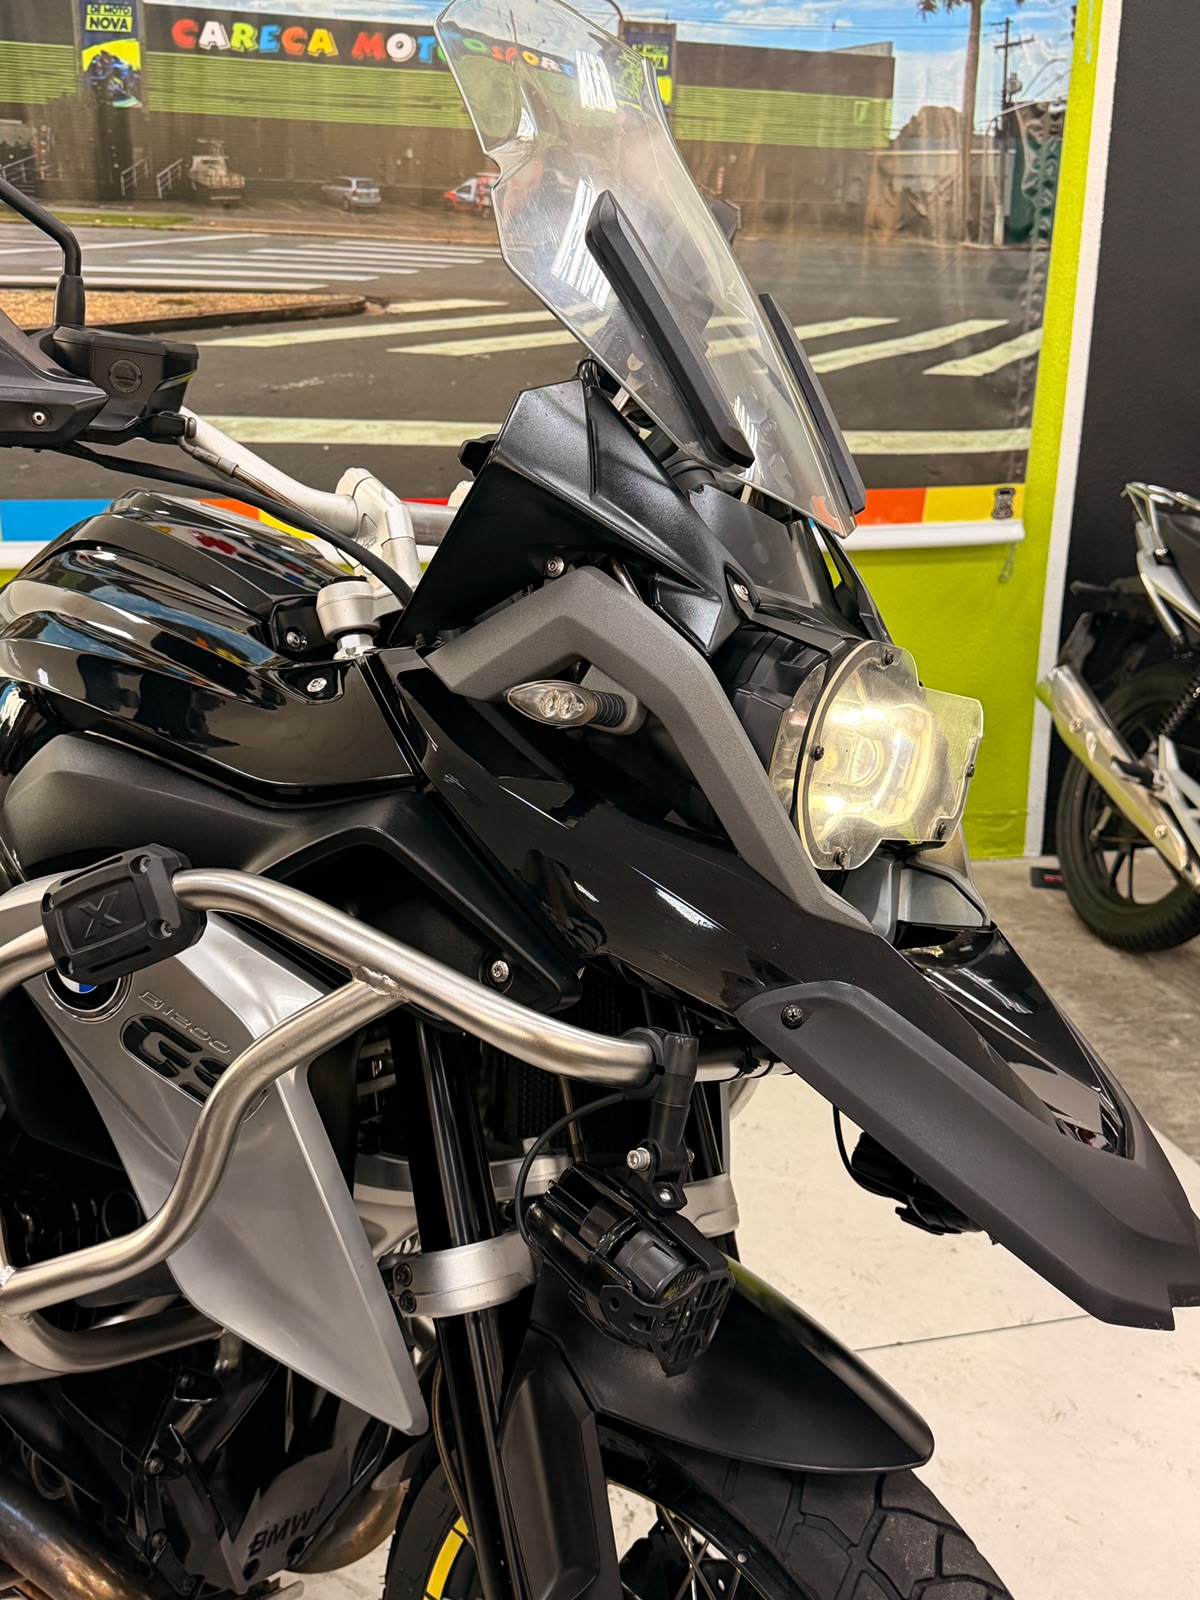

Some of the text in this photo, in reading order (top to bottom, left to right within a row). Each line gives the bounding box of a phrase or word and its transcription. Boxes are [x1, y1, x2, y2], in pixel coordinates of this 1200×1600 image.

[90, 17, 128, 30] NOVA
[172, 18, 339, 57] CARECA
[248, 1506, 316, 1557] BMW
